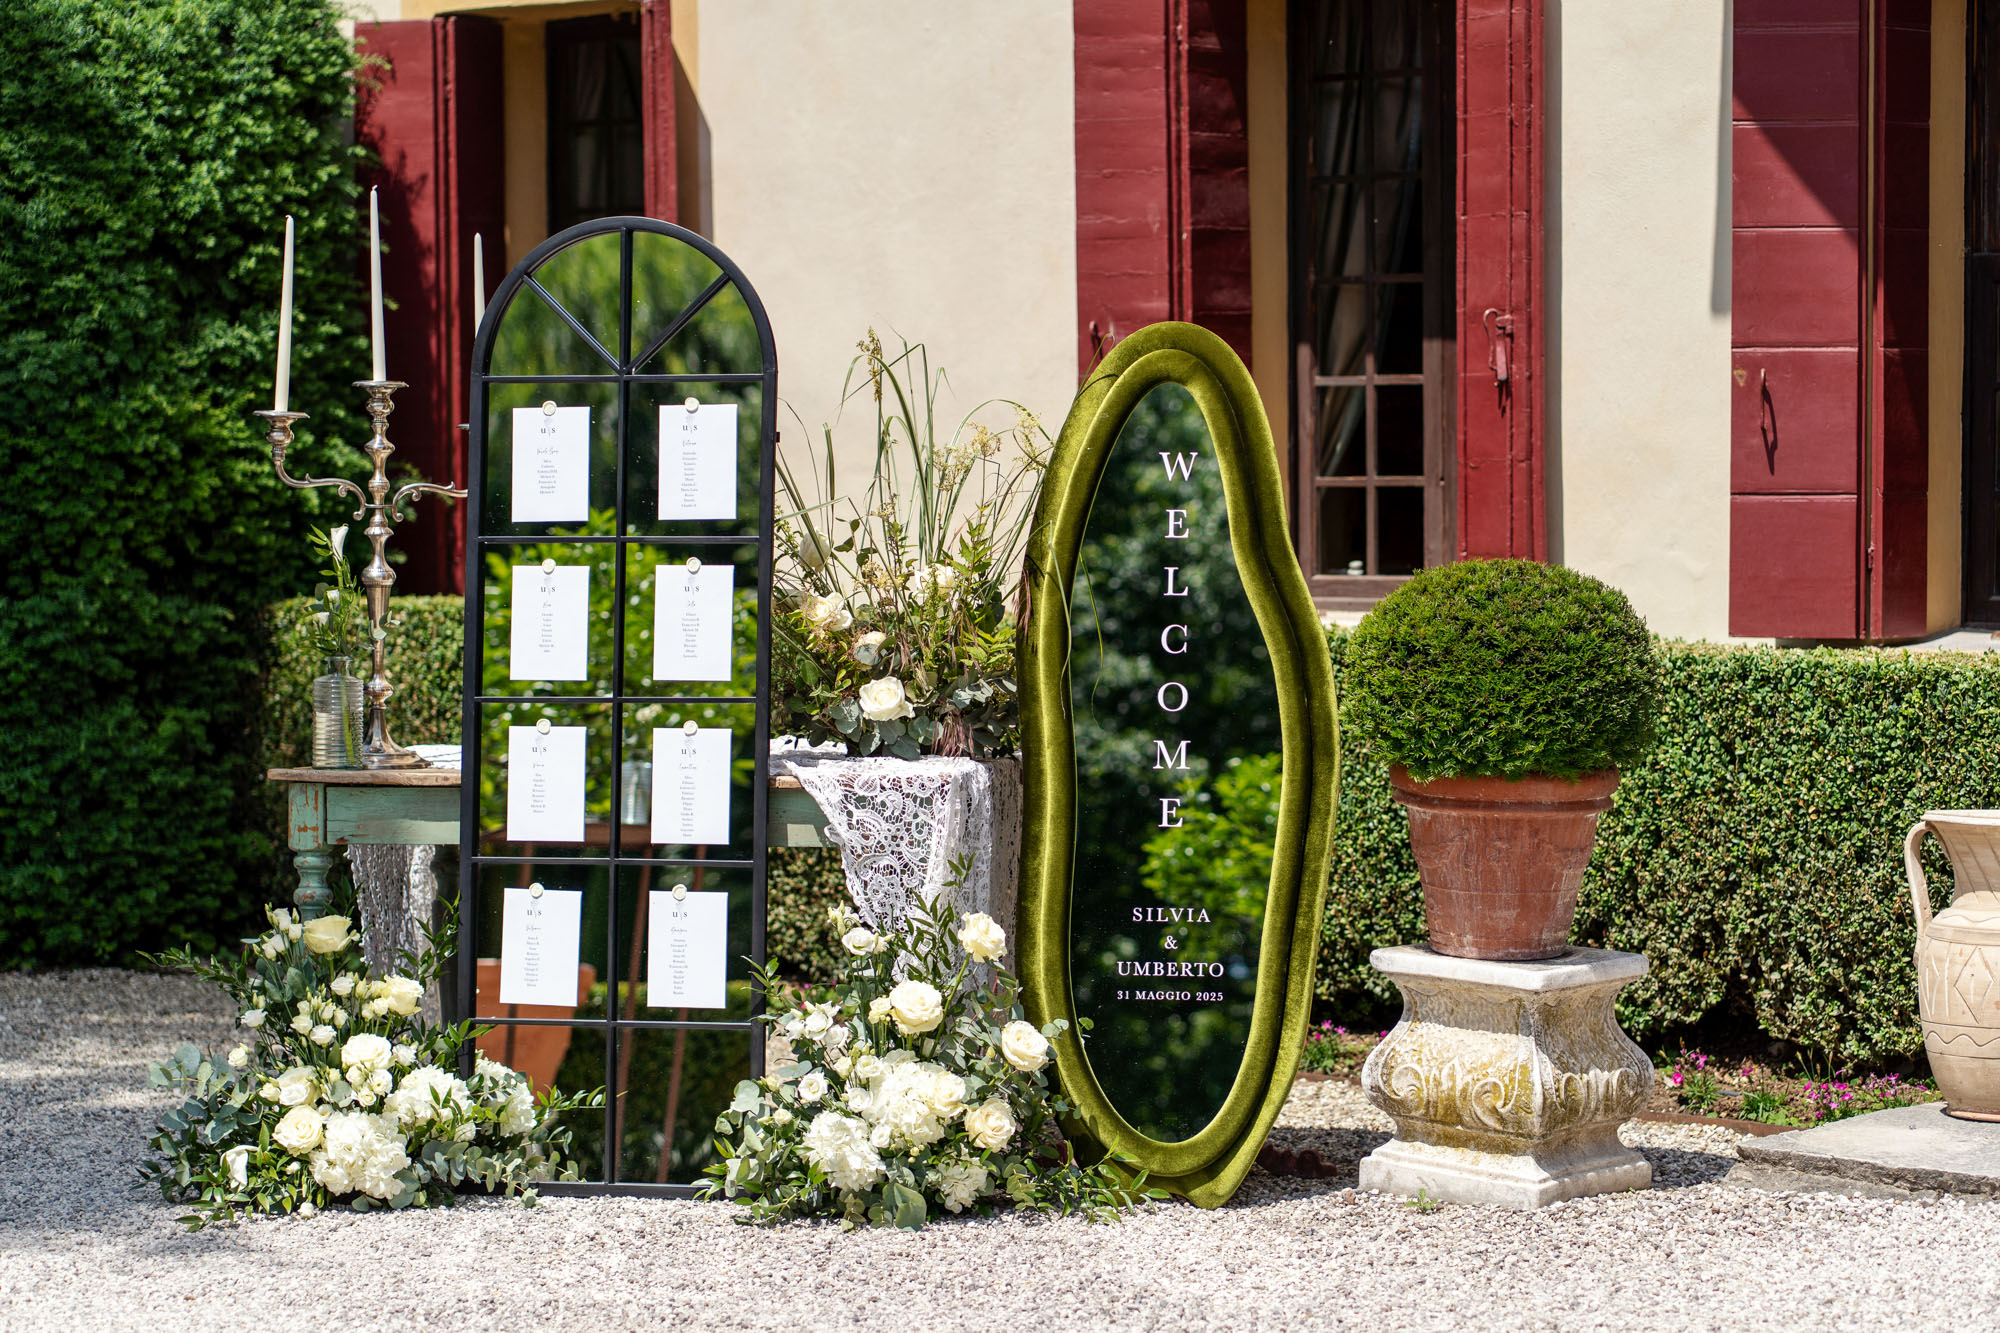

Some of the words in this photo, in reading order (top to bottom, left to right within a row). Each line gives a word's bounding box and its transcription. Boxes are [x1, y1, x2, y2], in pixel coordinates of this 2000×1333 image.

[1152, 452, 1199, 828] WELCOME
[1132, 907, 1211, 922] SILVIA
[1164, 936, 1178, 949] &
[1116, 961, 1224, 978] UMBERTO
[1117, 990, 1130, 1000] 31
[1135, 990, 1191, 1001] MAGGIO
[1196, 991, 1224, 1002] 2025
